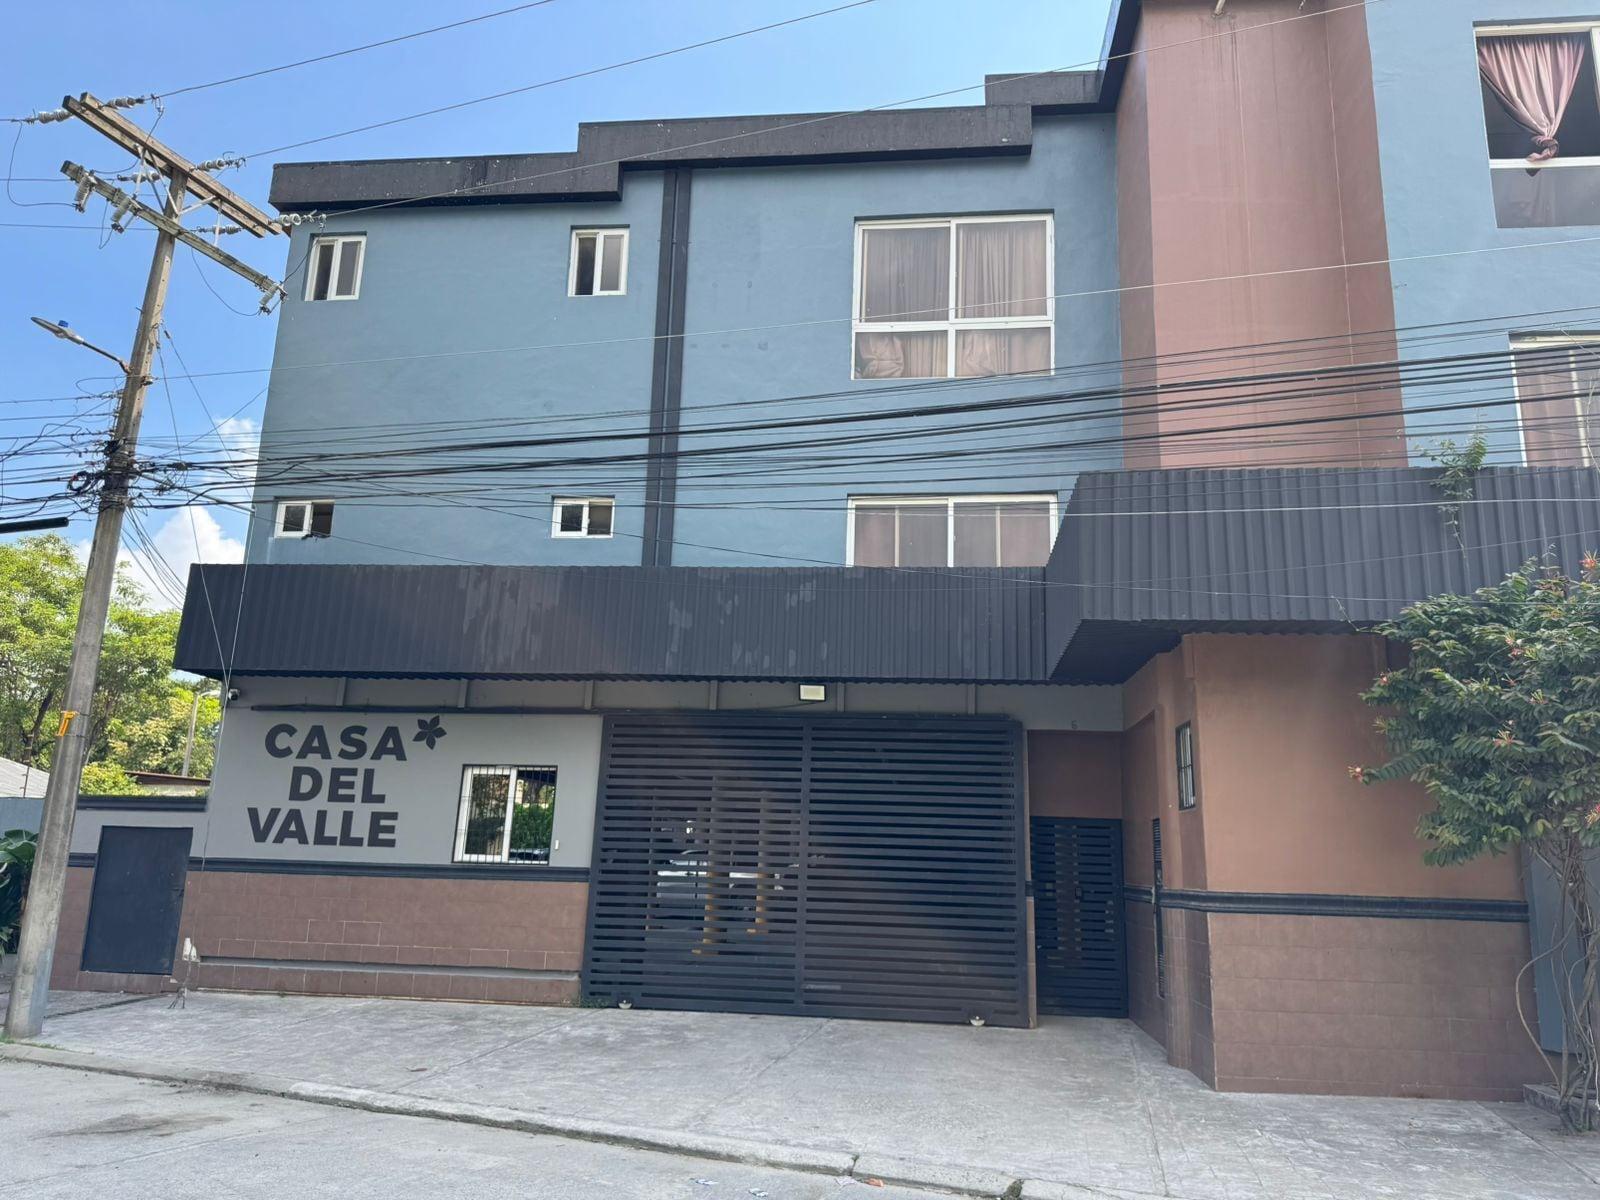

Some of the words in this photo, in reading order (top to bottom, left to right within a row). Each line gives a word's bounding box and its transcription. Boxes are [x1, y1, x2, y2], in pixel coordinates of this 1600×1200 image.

[265, 724, 407, 761] CASA
[288, 766, 386, 803] DEL
[247, 807, 398, 847] VALLE
